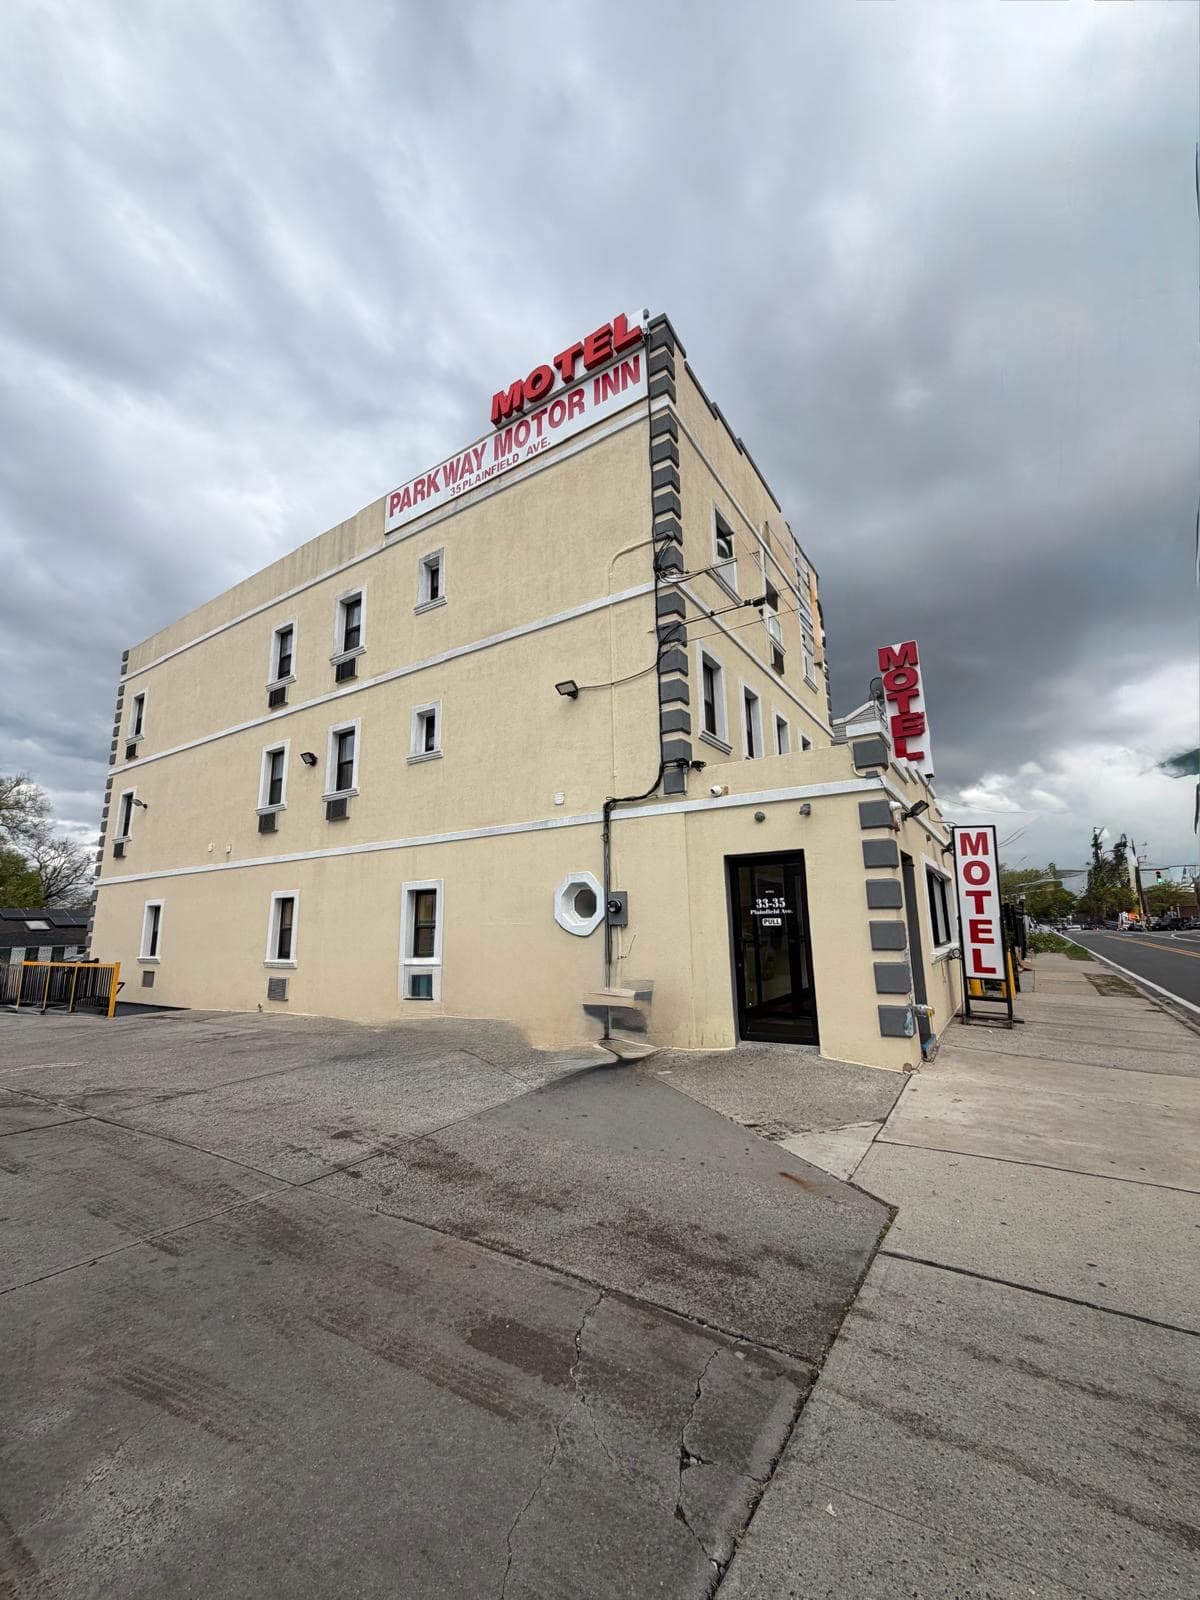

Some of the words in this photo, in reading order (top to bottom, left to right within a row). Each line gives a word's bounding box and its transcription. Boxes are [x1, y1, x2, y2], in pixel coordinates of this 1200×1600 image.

[490, 312, 644, 425] MOTEL
[389, 442, 487, 518] PARKWAY
[493, 387, 585, 461] MOTOR
[593, 354, 641, 406] INN
[462, 453, 519, 491] PLAINFIELD
[526, 436, 551, 457] AVE.
[878, 640, 925, 761] MOTEL
[756, 897, 786, 908] 33-35
[959, 832, 997, 975] MOTEL
